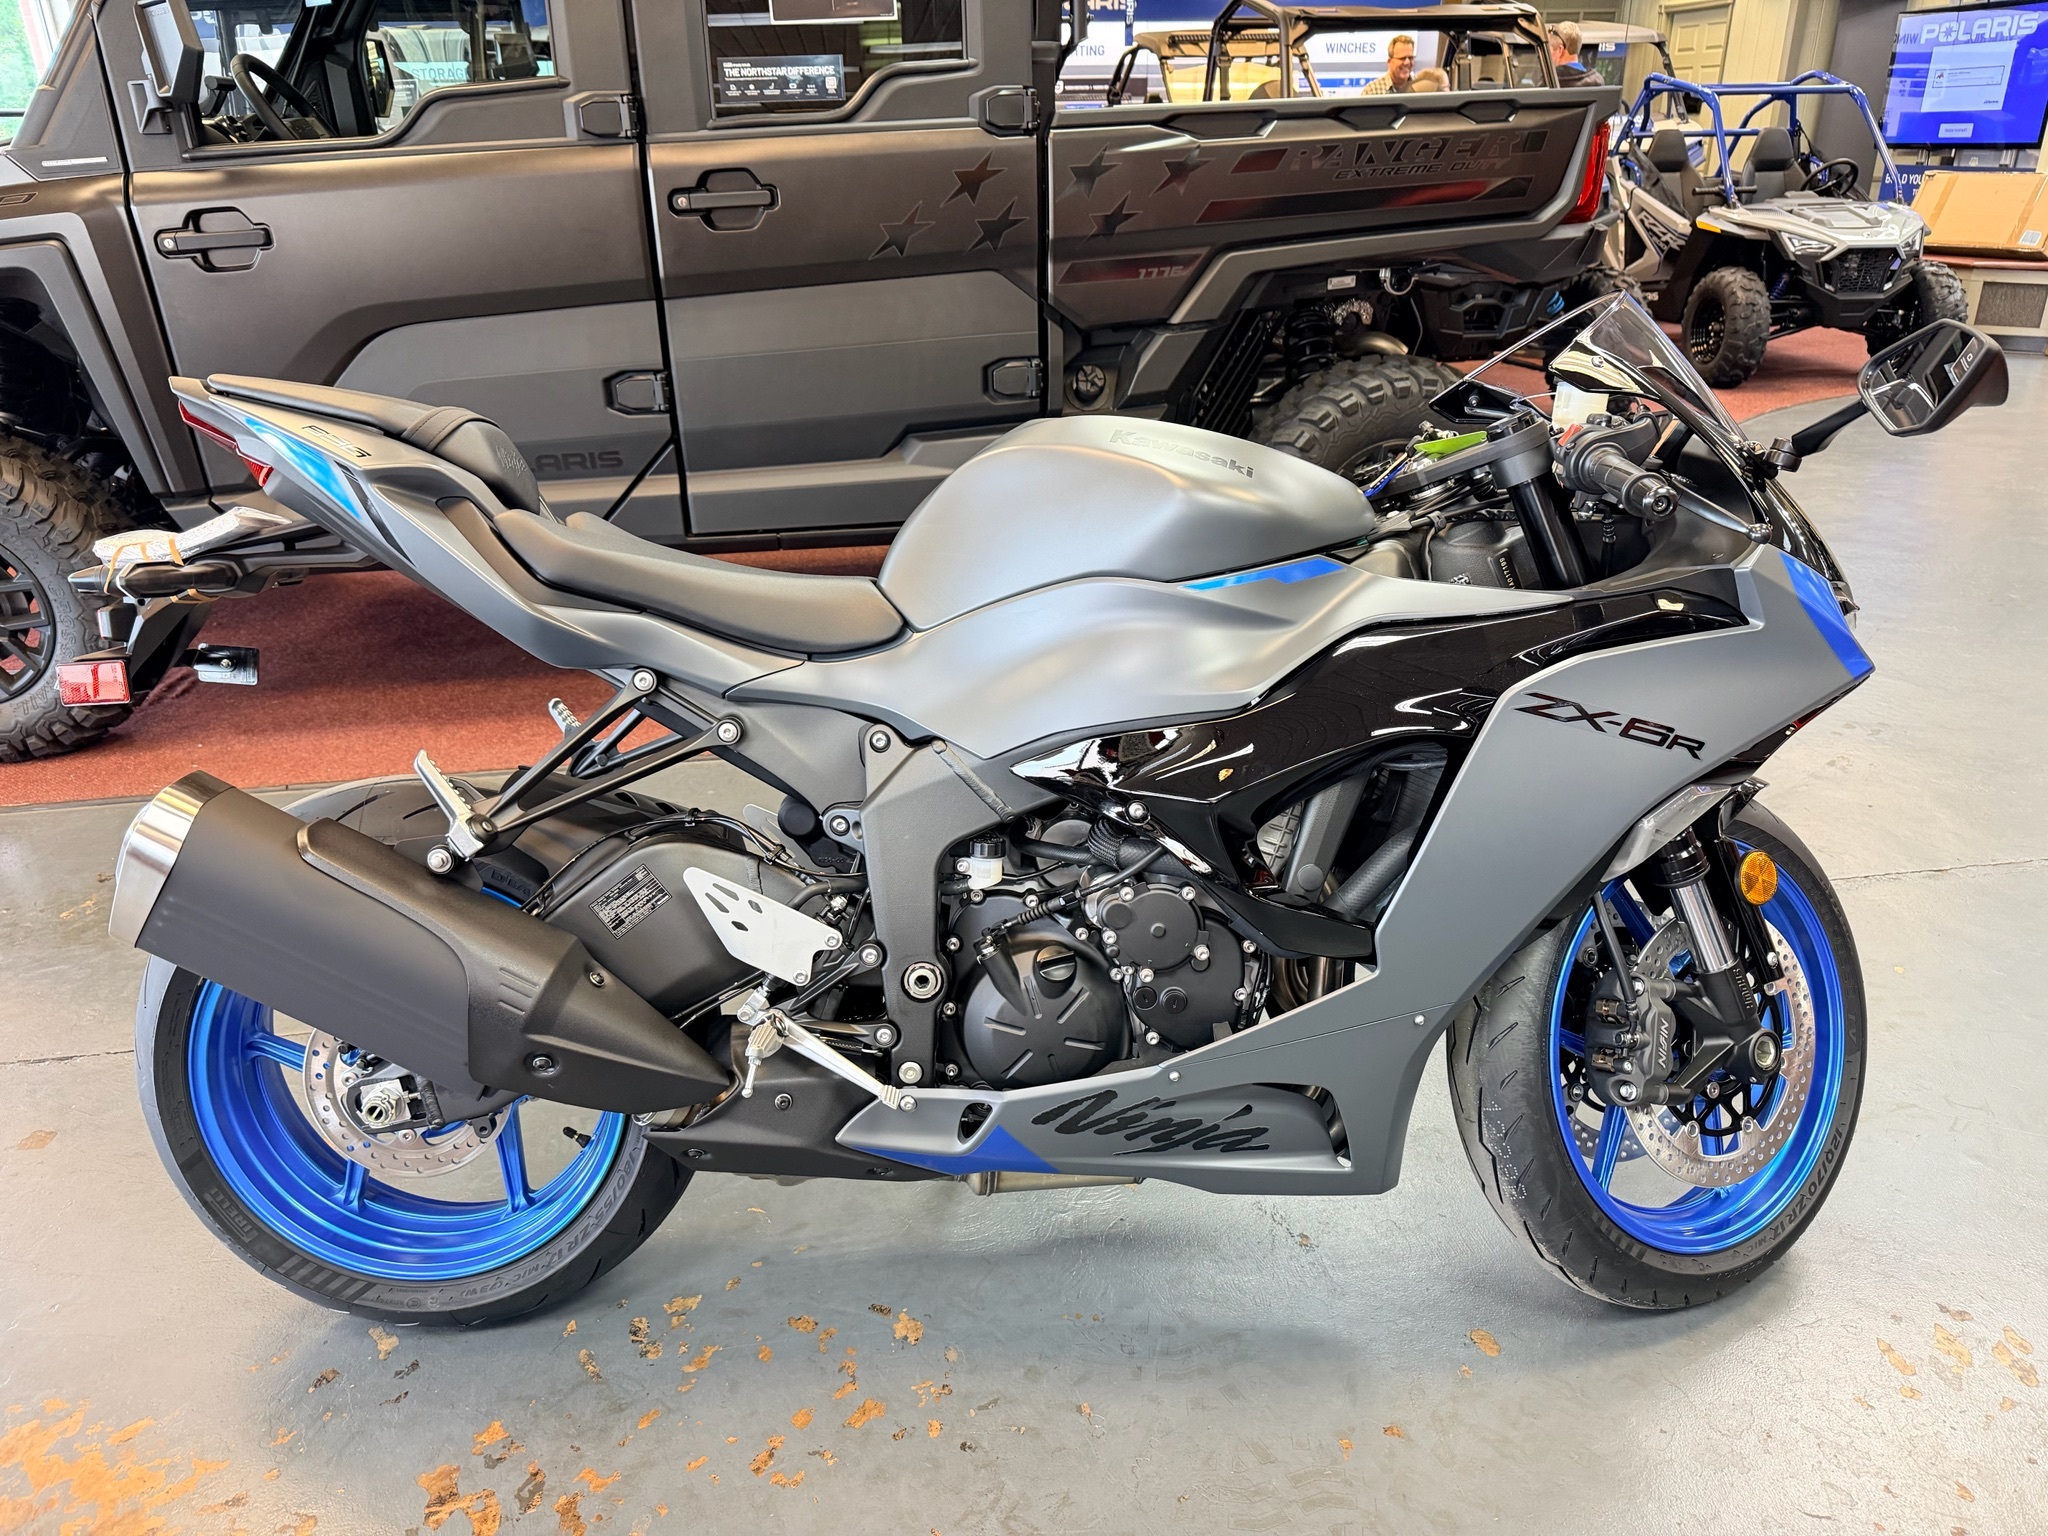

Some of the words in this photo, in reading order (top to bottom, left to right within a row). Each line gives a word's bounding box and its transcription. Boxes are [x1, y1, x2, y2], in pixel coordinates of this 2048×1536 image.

[1920, 13, 2039, 44] POLARIS
[1325, 42, 1376, 53] WINCHES
[411, 67, 465, 80] STORAG
[723, 68, 740, 77] THE
[740, 67, 787, 77] NORTHSTAR
[787, 65, 835, 76] DIFFERENCE
[1290, 131, 1522, 171] RANGER
[1334, 163, 1442, 180] EXTREME
[1449, 157, 1511, 172] DUTY
[1638, 211, 1687, 252] RZR
[1137, 265, 1184, 280] 1776
[531, 450, 623, 473] ARIS
[1109, 429, 1254, 479] Kawasaki
[1513, 691, 1706, 761] ZX-6R
[490, 868, 531, 896] DIA
[1657, 1017, 1670, 1069] NISSIN
[1031, 1089, 1270, 1156] Ninja
[203, 1187, 259, 1243] PIRELLI
